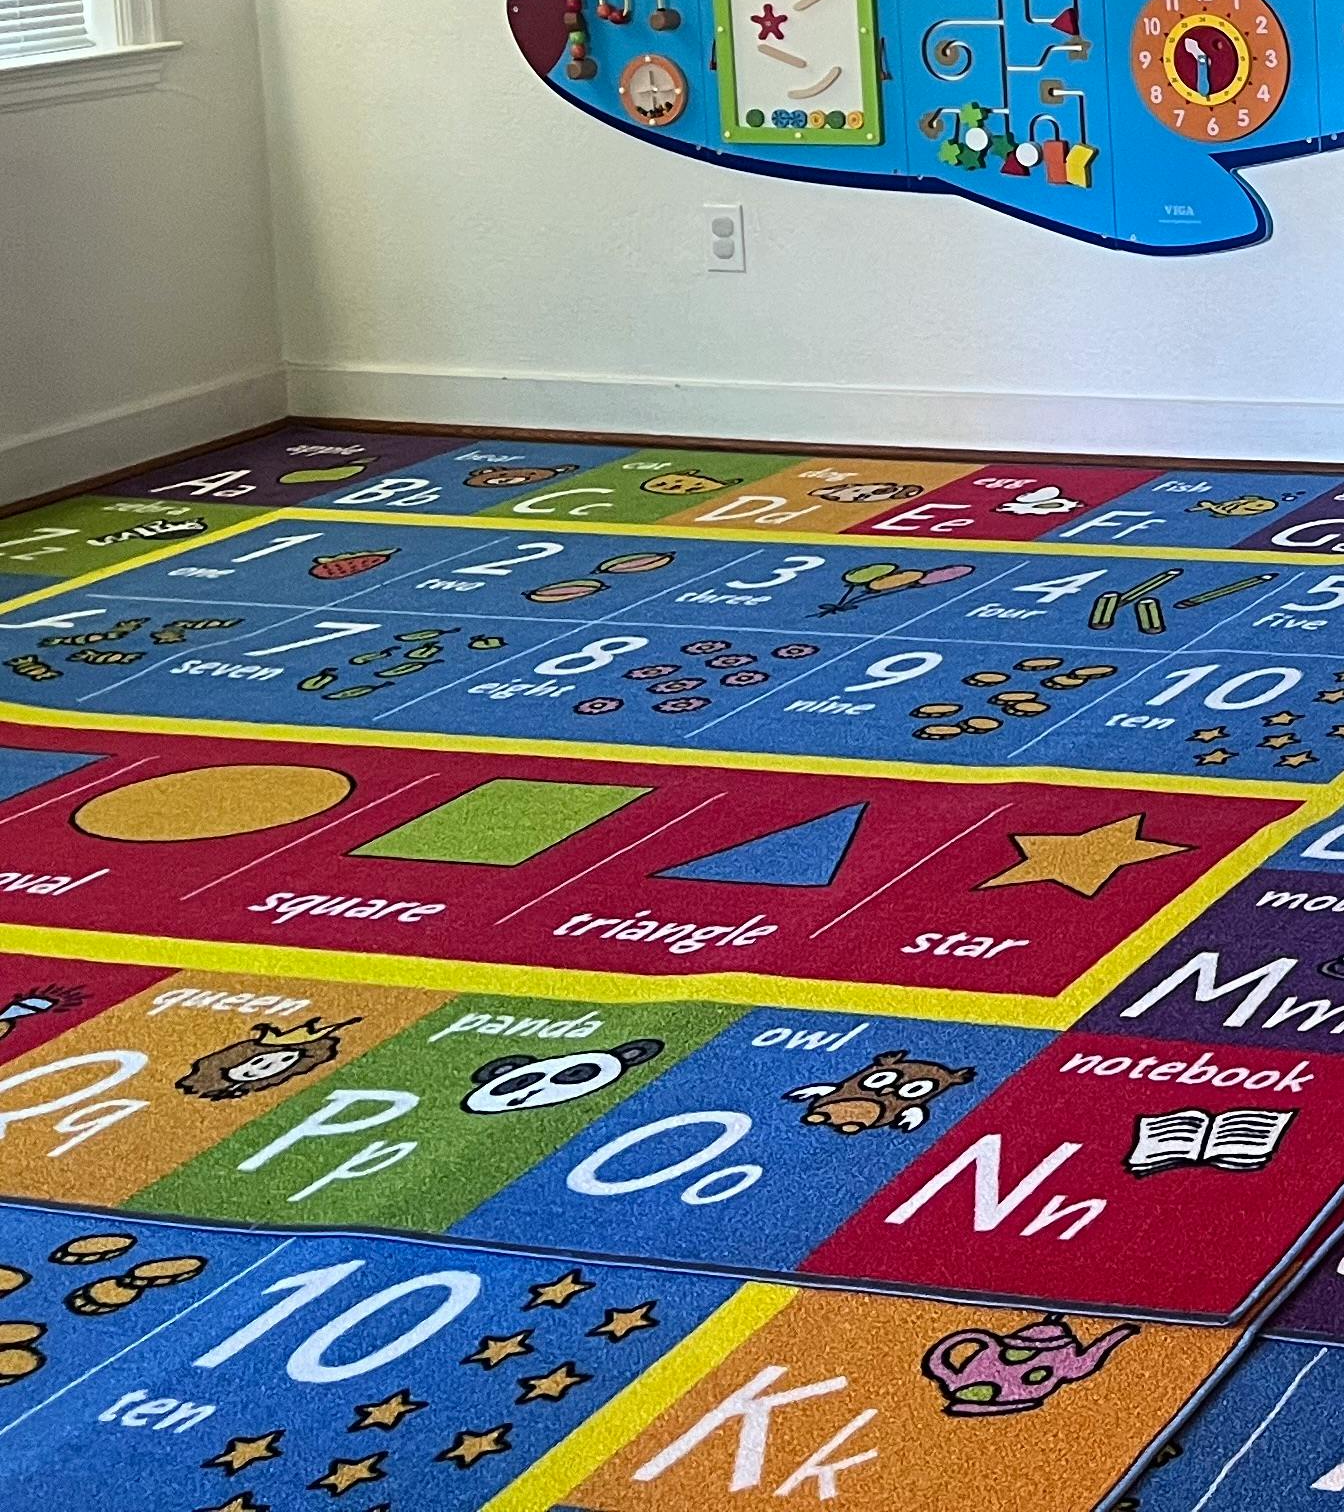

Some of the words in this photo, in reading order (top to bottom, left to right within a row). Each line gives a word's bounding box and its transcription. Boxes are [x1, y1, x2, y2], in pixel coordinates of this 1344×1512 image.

[1143, 17, 1161, 35] 10
[1255, 16, 1268, 34] 2
[1139, 50, 1151, 69] 9
[1265, 50, 1278, 68] 3
[1150, 85, 1162, 104] 8
[1257, 84, 1270, 102] 4
[1173, 110, 1185, 127] 7
[1207, 117, 1219, 136] 6
[1238, 109, 1250, 127] 5
[1164, 205, 1195, 216] VIGA
[799, 468, 858, 482] dog
[973, 478, 1037, 489] egg
[1152, 481, 1212, 492] fish
[232, 533, 324, 562] 1
[454, 543, 563, 575] 2
[727, 555, 825, 588] 3
[416, 579, 485, 591] two
[1013, 570, 1109, 603] 4
[675, 589, 771, 605] three
[966, 603, 1047, 619] four
[1253, 613, 1327, 630] five
[244, 622, 382, 656] 7
[534, 637, 652, 677] 8
[170, 660, 284, 680] seven
[845, 651, 942, 691] 9
[468, 679, 575, 699] eight
[1148, 664, 1302, 709] 10
[784, 696, 879, 714] nine
[1105, 714, 1175, 729] ten
[248, 893, 445, 923] square
[553, 911, 778, 953] triangle
[901, 925, 1034, 958] star
[147, 988, 311, 1016] queen
[428, 1011, 604, 1042] panda
[752, 1023, 869, 1051] owl
[1060, 1053, 1314, 1092] notebook
[193, 1259, 481, 1383] 10
[98, 1389, 216, 1433] ten
